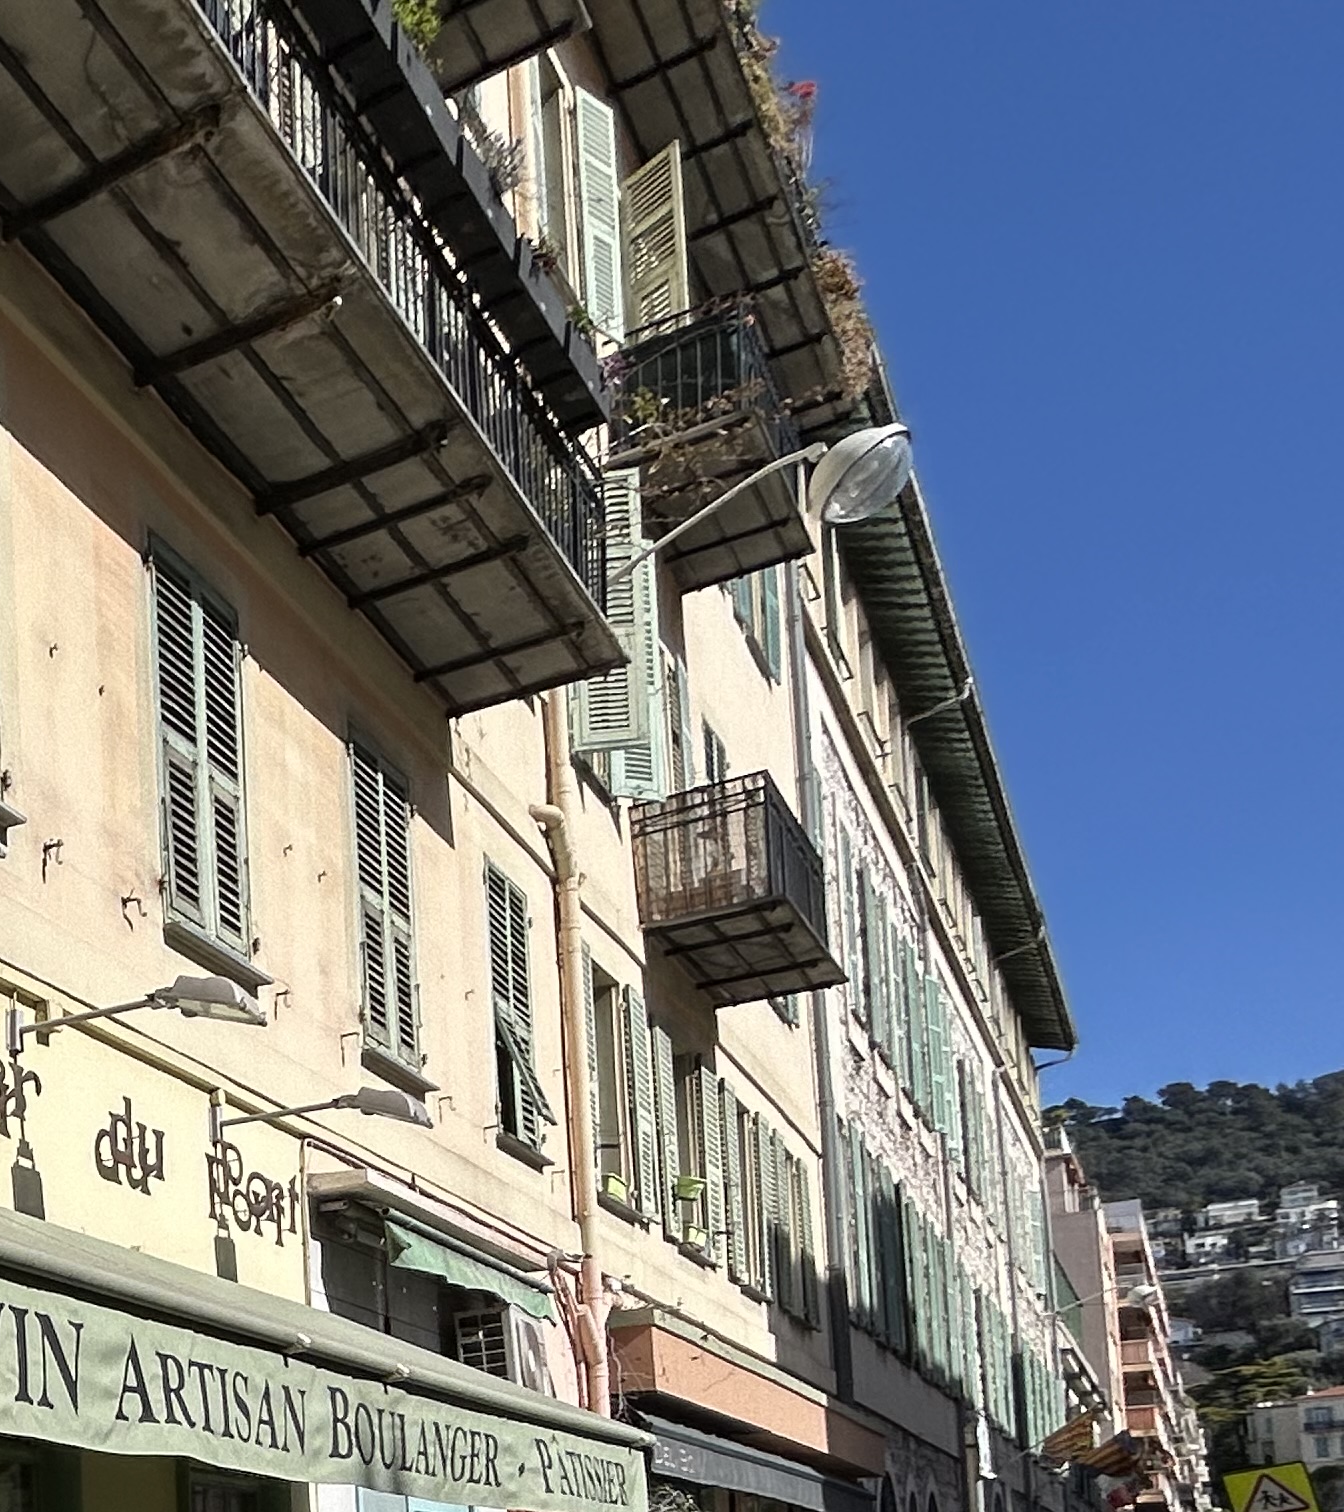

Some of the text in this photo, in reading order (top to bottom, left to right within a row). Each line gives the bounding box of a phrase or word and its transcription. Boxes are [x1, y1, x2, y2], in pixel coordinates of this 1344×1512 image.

[104, 1096, 164, 1184] du
[209, 1140, 299, 1235] Port
[115, 1333, 307, 1457] ARTISAN
[328, 1386, 502, 1488] BOULANGER
